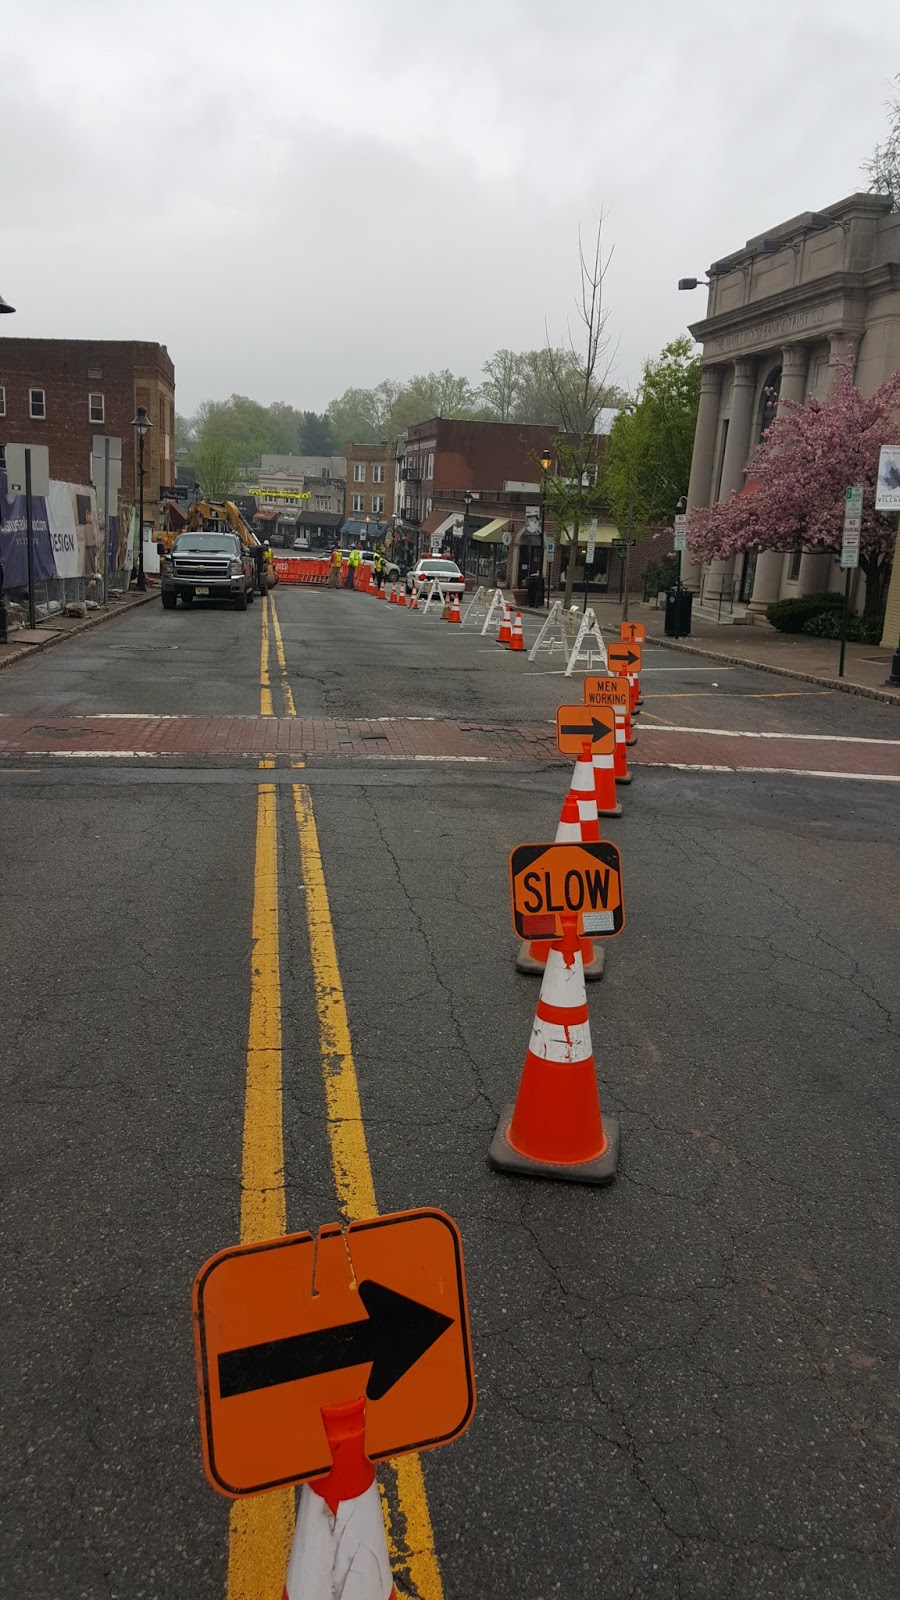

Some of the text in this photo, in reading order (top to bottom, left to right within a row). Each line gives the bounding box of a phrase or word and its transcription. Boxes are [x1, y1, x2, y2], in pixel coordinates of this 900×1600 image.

[789, 312, 809, 331] TRUST
[50, 533, 75, 552] DESIGN
[597, 681, 617, 692] MEN
[588, 692, 626, 705] WORKING
[523, 868, 610, 913] SLOW
